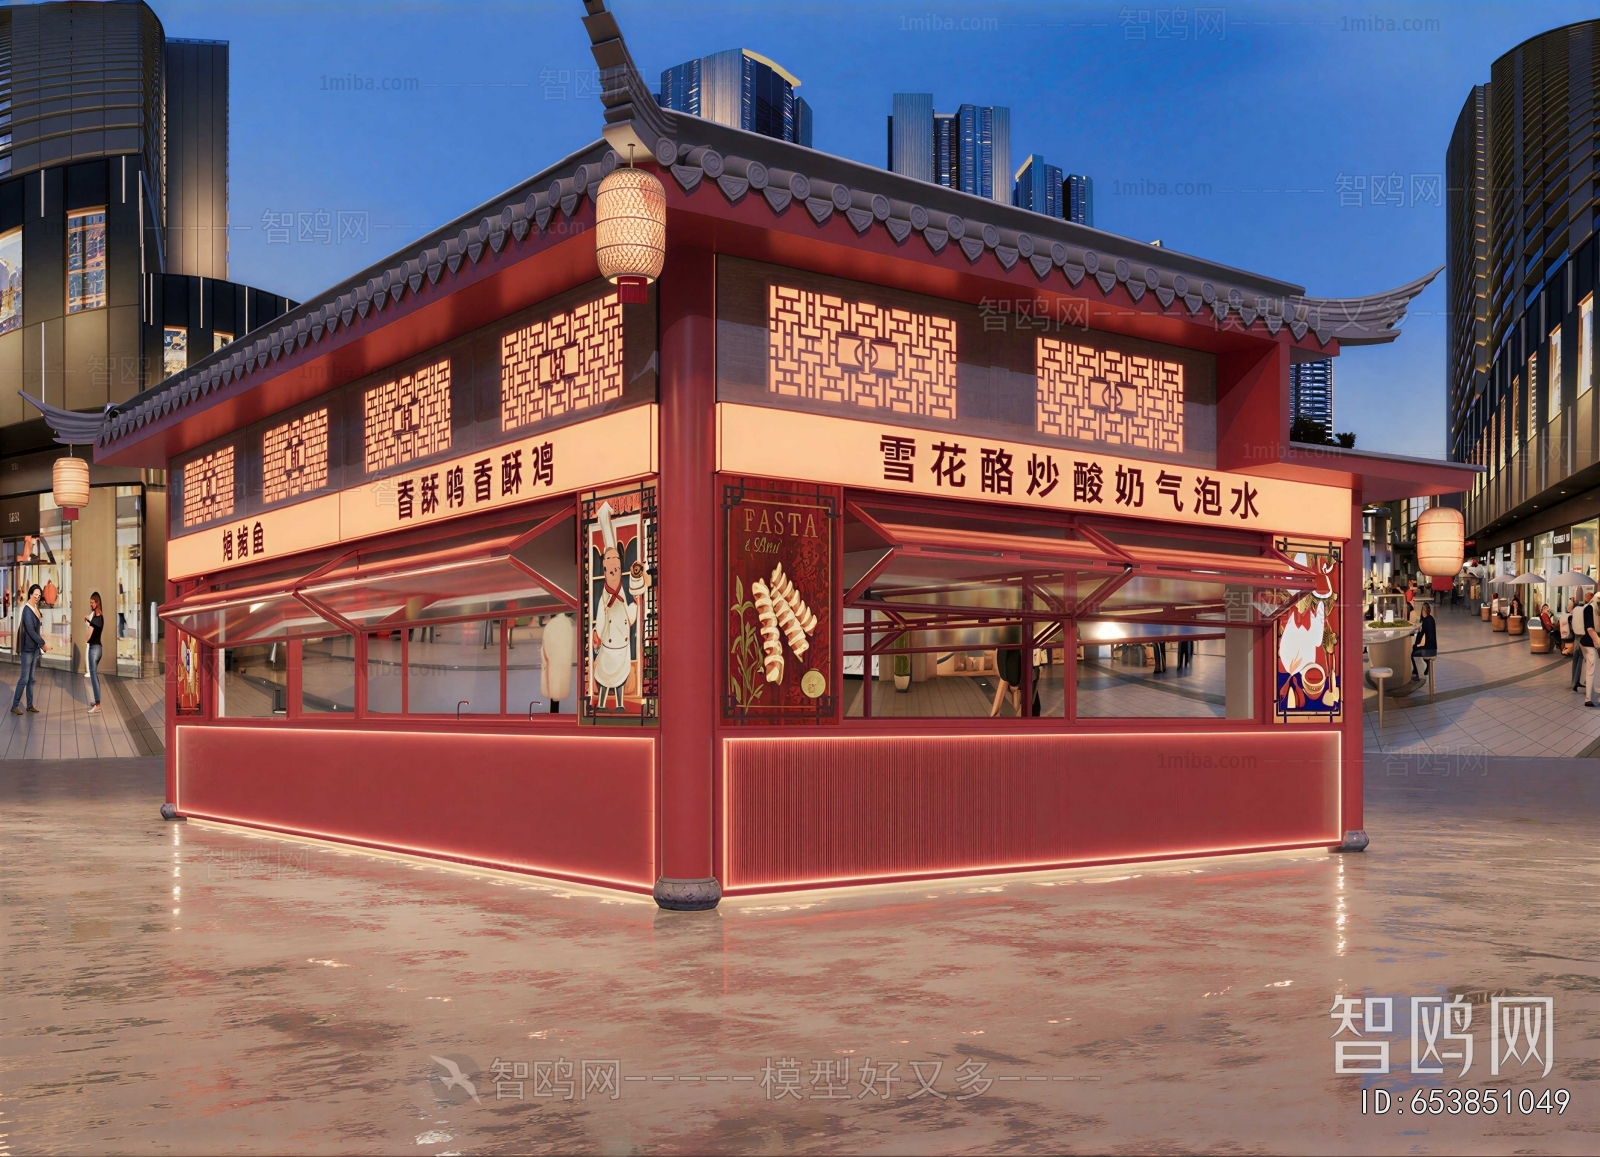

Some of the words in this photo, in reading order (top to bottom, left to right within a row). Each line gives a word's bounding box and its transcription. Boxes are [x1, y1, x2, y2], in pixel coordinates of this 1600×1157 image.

[880, 434, 1260, 520] 雪花酪炒酸奶气泡水
